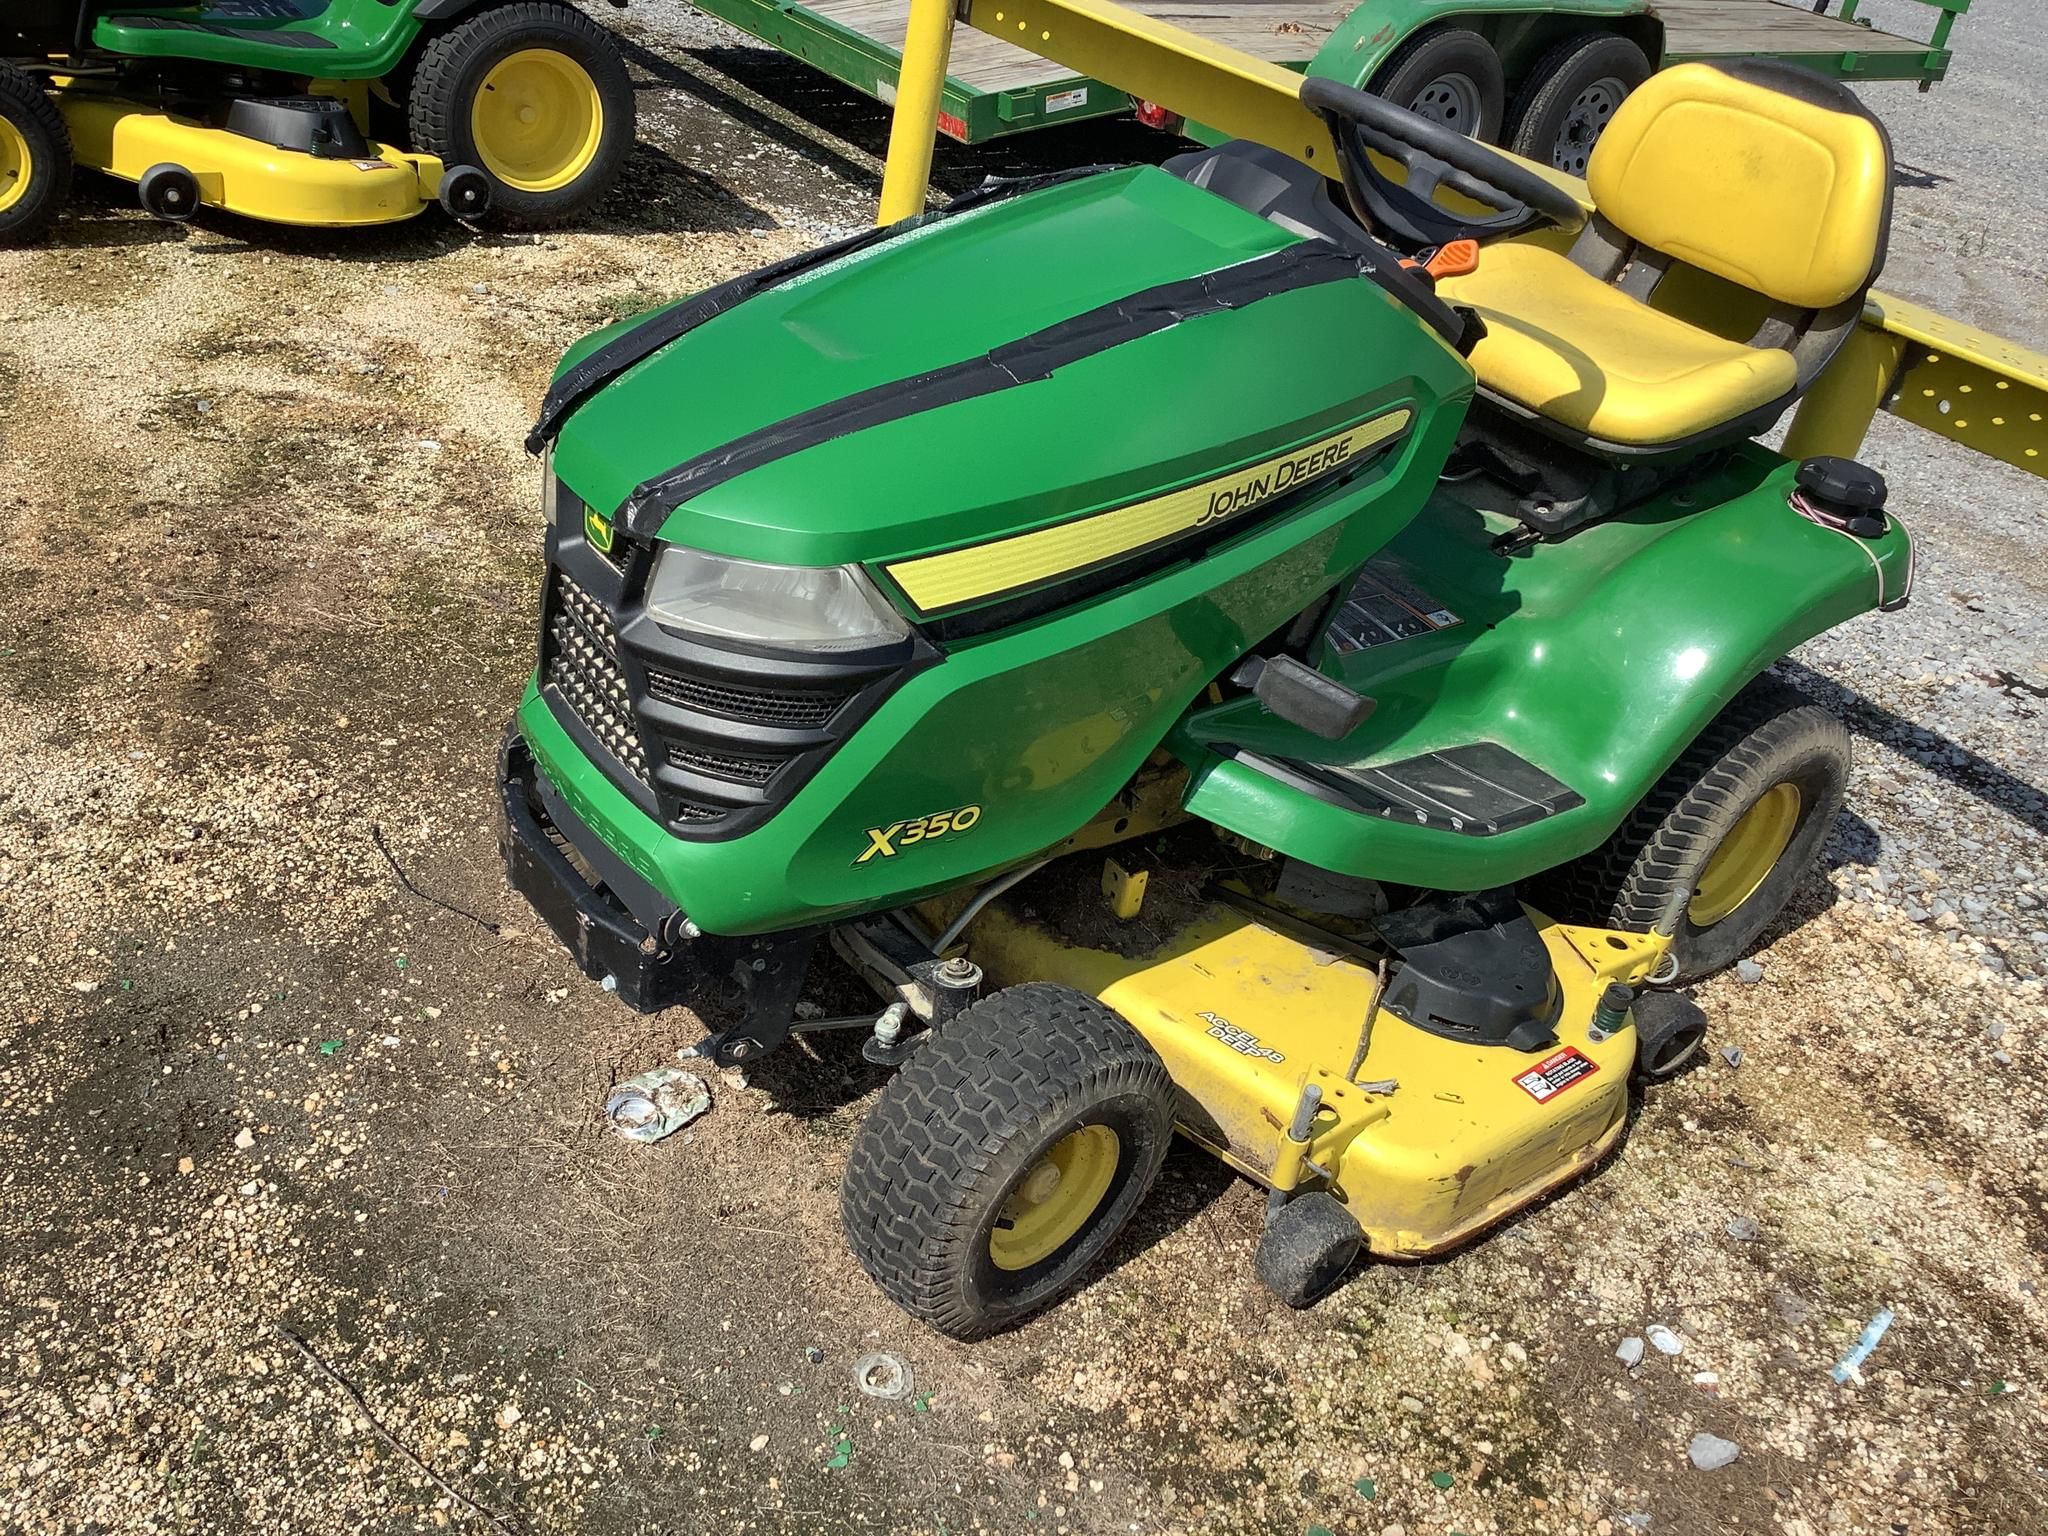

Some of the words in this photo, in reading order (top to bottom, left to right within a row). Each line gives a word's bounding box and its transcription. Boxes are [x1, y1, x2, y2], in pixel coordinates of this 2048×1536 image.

[1196, 474, 1271, 525] JOHN
[1274, 436, 1353, 492] DEERE
[854, 804, 982, 864] X350
[1195, 1011, 1261, 1050] ACCEL
[1258, 1047, 1286, 1064] 48
[1205, 1026, 1263, 1057] DEEP
